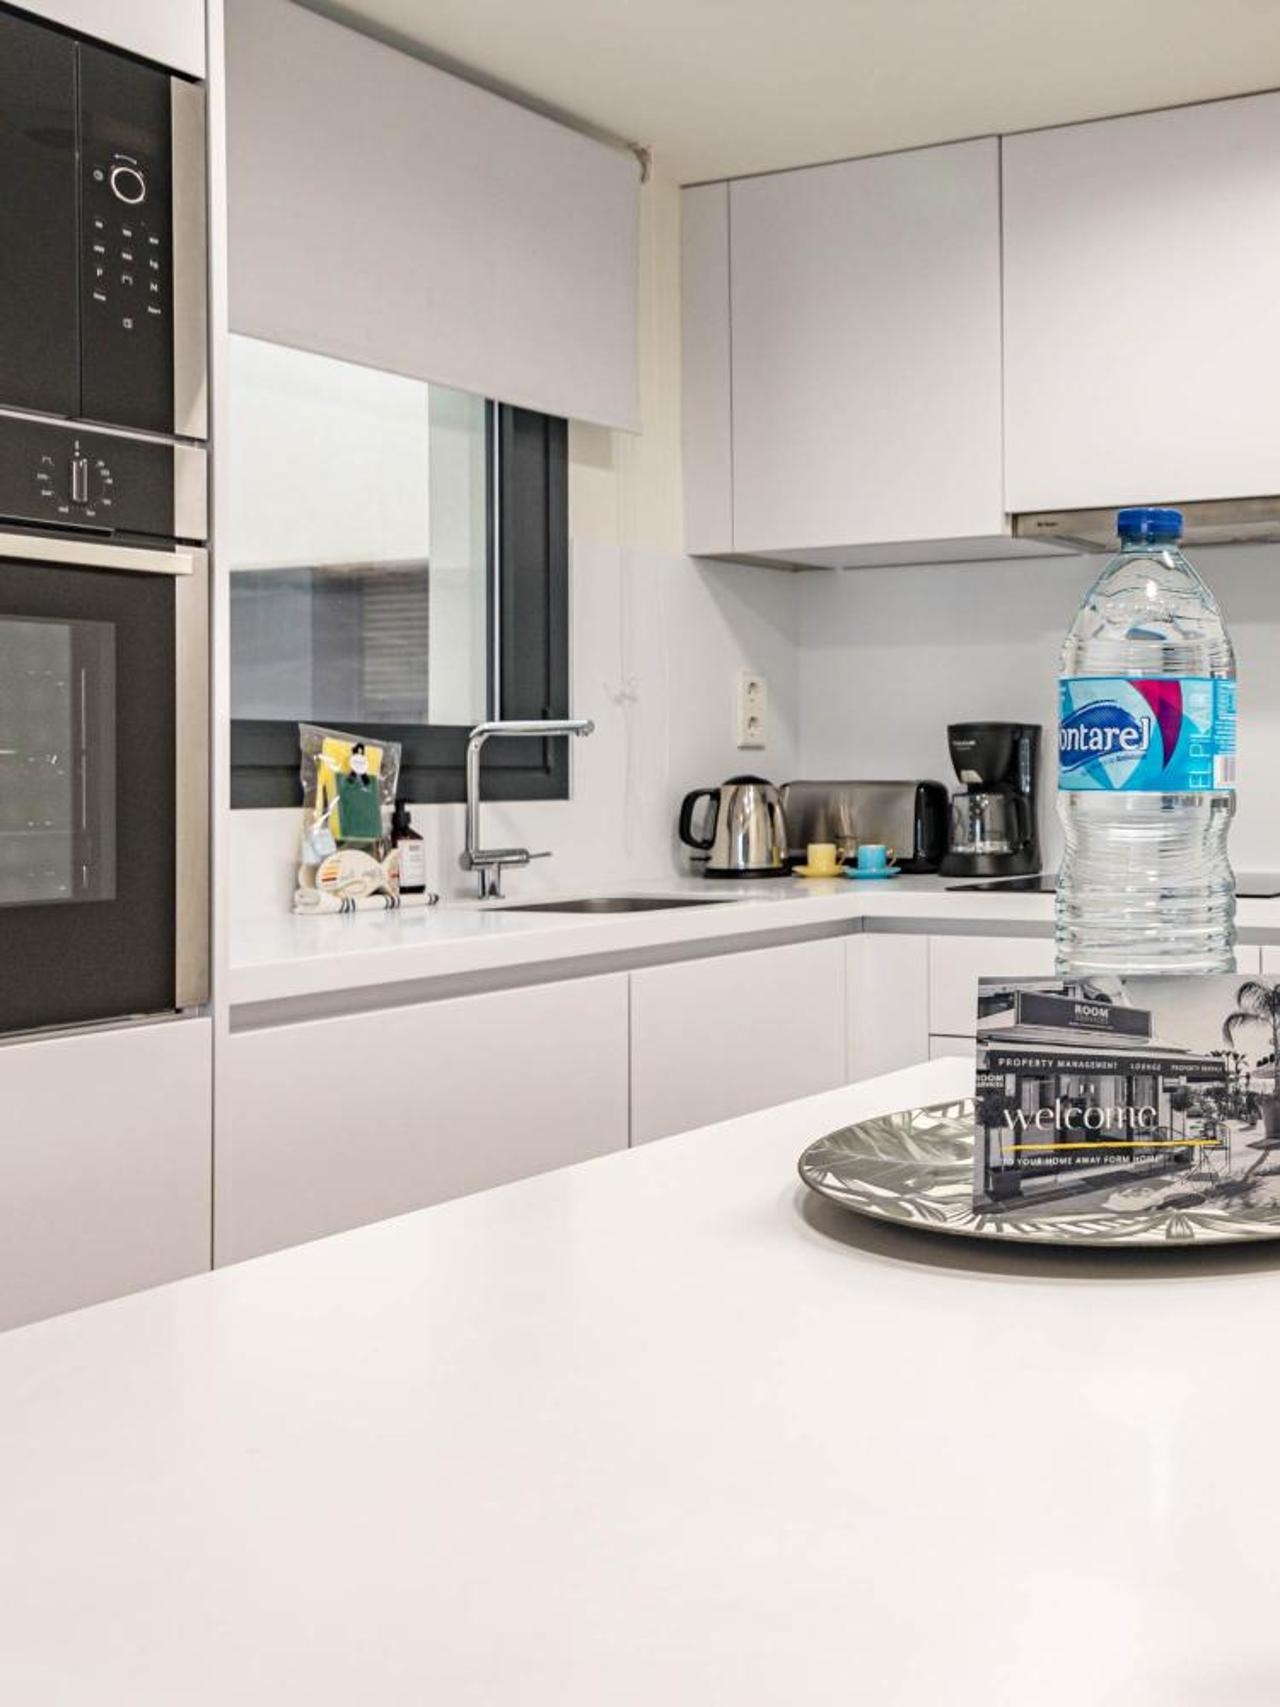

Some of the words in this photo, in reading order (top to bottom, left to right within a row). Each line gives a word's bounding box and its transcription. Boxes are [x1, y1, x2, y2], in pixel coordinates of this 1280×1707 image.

[1059, 716, 1151, 752] ontarel
[1074, 1004, 1109, 1018] ROOM
[997, 1057, 1054, 1068] PROPERTY
[1057, 1059, 1118, 1070] MANAGEMENT
[1003, 1097, 1157, 1131] welcome
[1017, 1157, 1042, 1166] YOUR
[1045, 1156, 1072, 1166] HOME
[1075, 1155, 1101, 1165] AWAY
[1104, 1154, 1130, 1164] FORM
